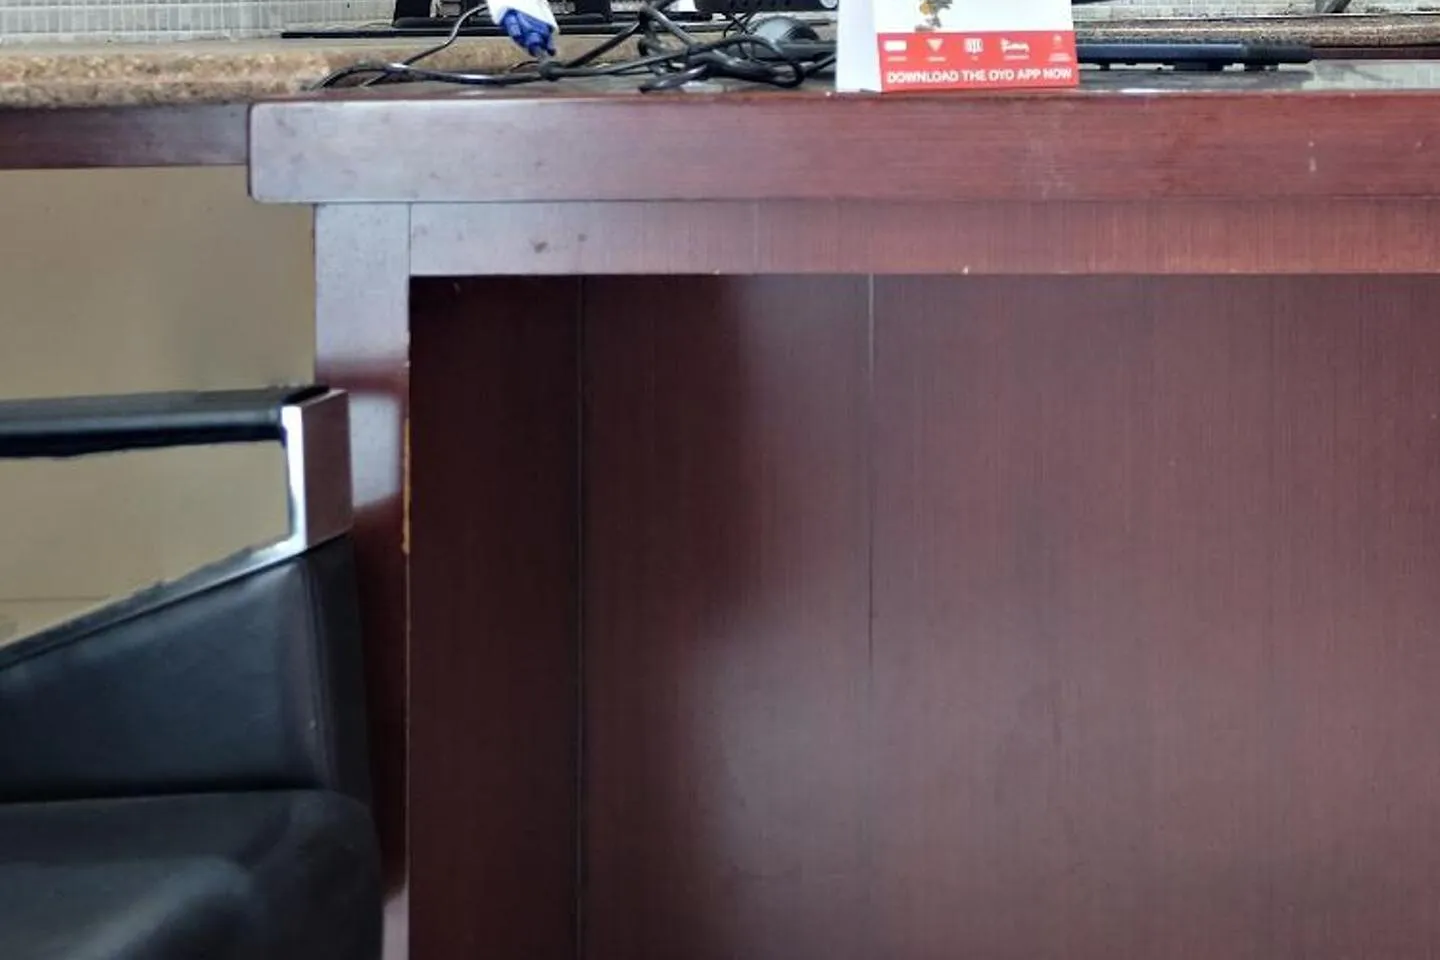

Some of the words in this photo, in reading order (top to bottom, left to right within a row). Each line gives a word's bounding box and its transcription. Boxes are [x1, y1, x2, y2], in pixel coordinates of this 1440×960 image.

[887, 70, 959, 84] DOWNLOAD
[962, 70, 987, 82] THE
[989, 68, 1015, 81] OYO
[1017, 67, 1041, 80] APP
[1043, 66, 1072, 79] NOW
